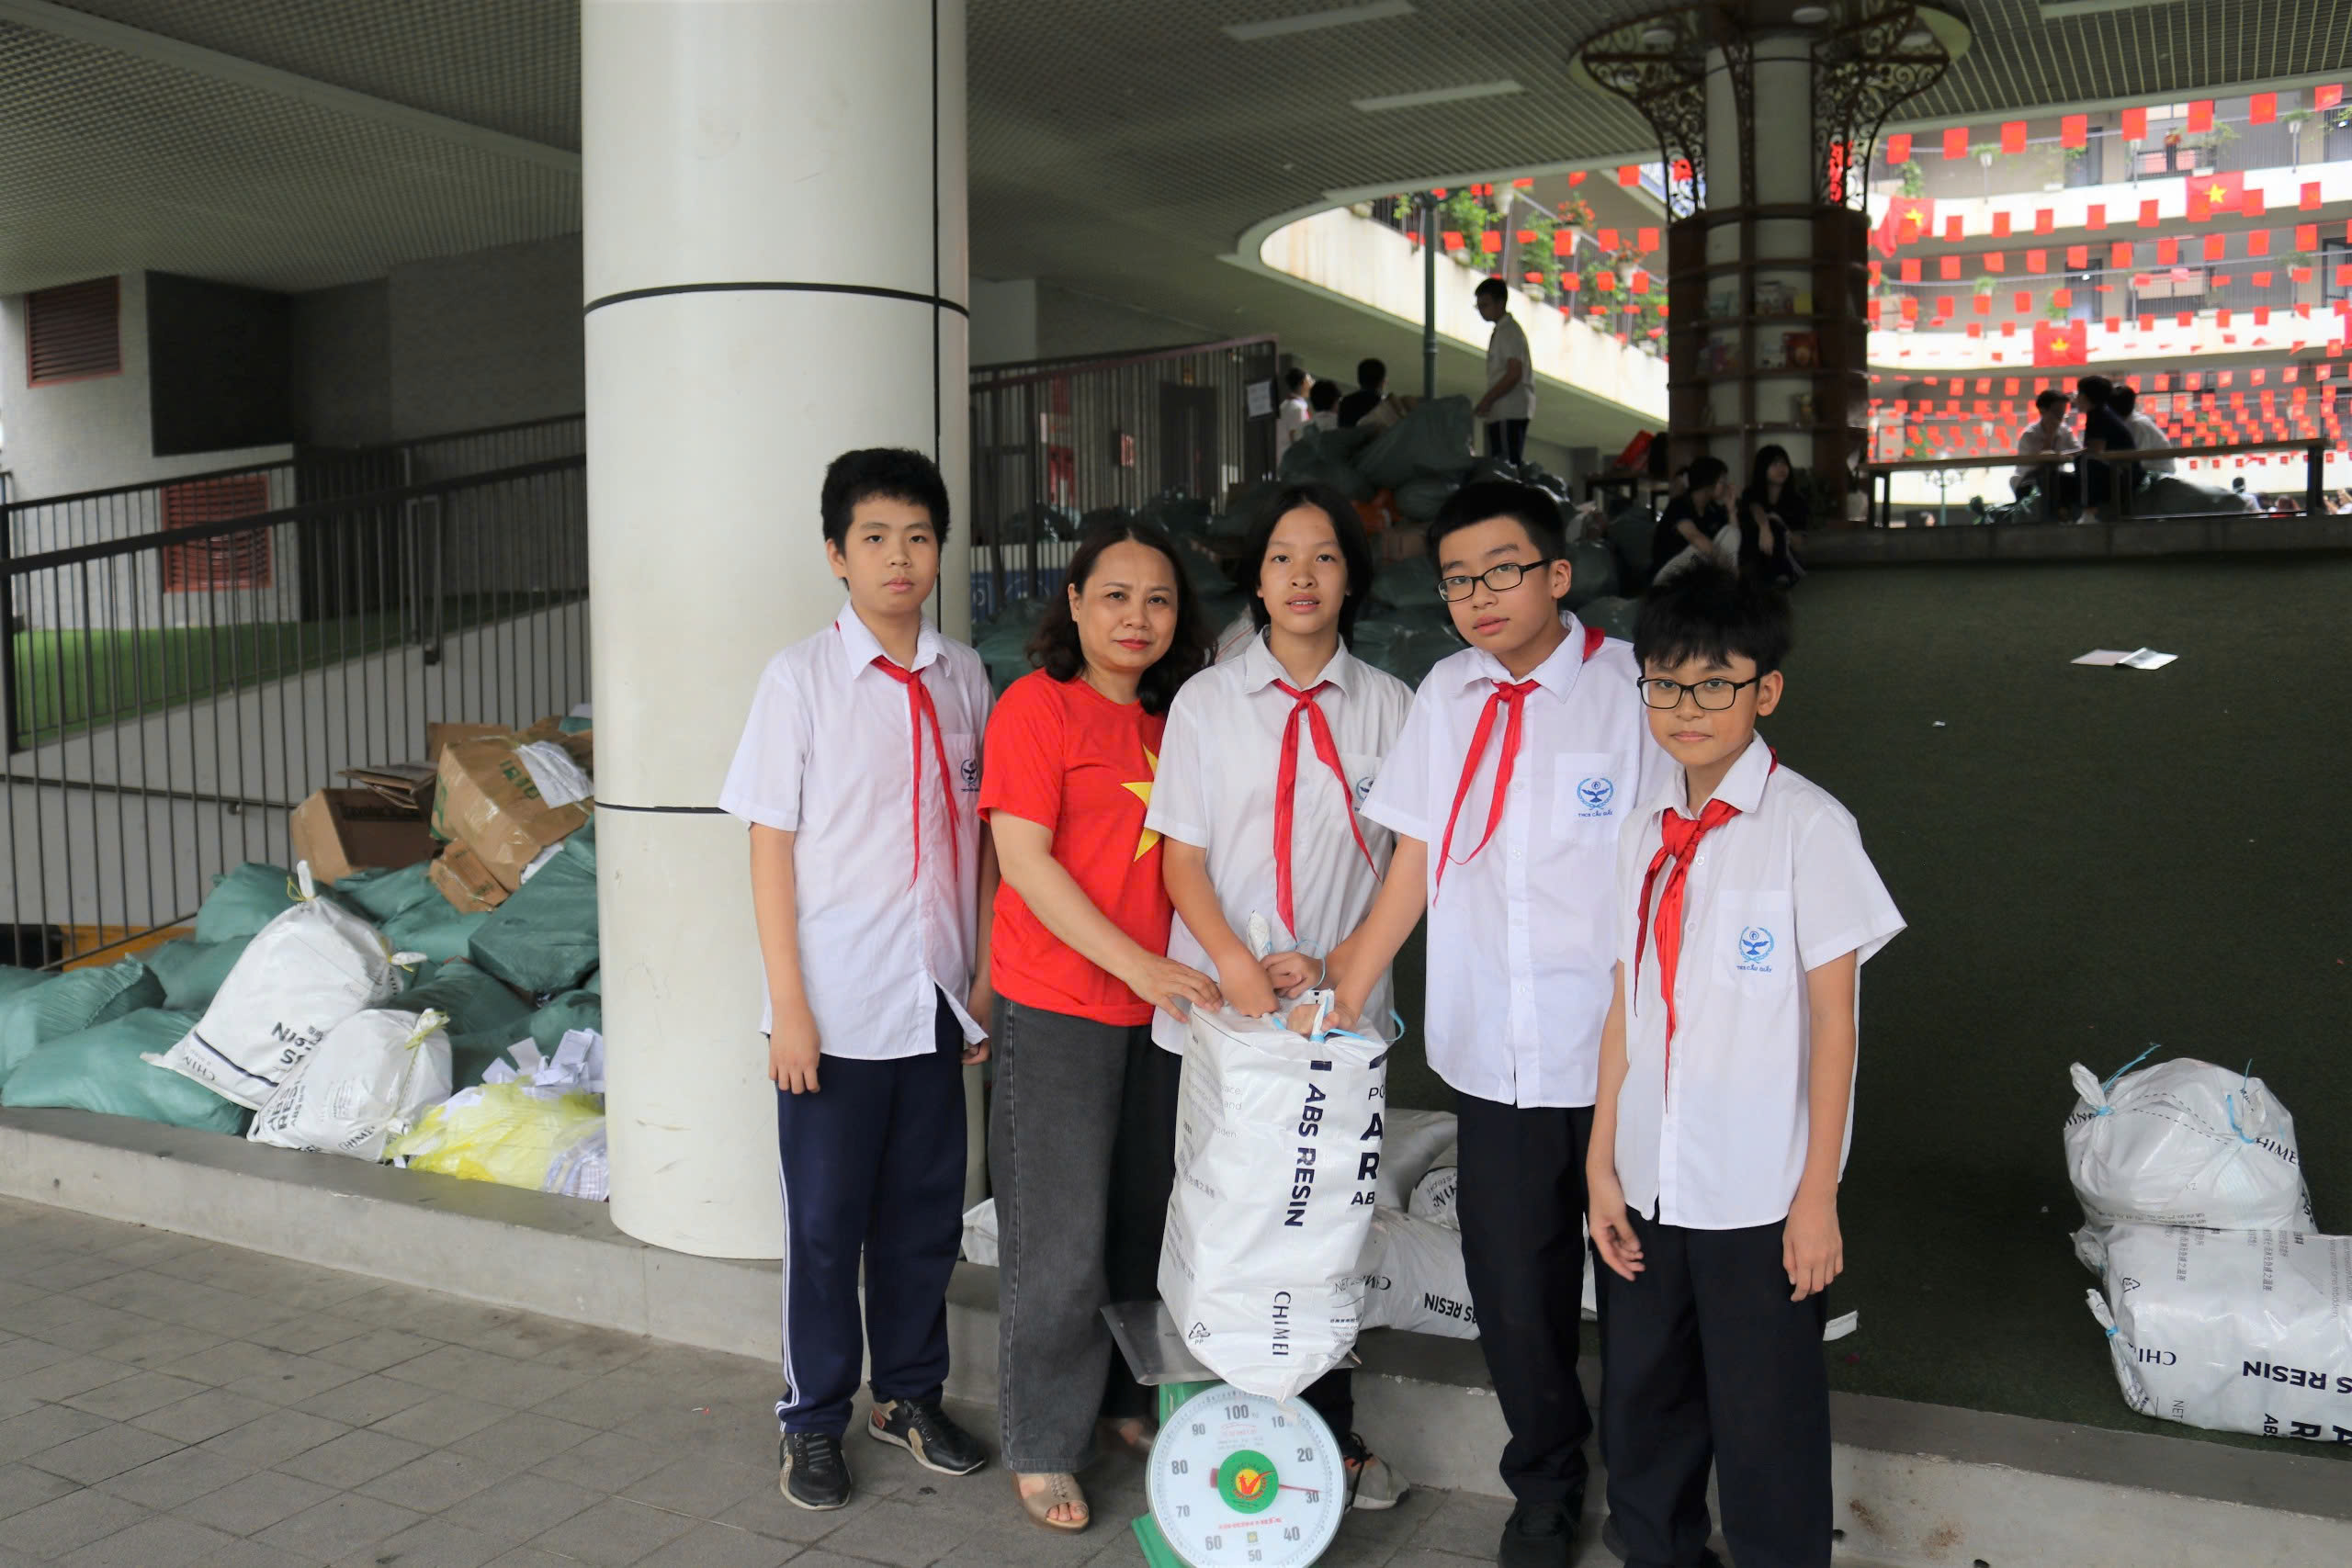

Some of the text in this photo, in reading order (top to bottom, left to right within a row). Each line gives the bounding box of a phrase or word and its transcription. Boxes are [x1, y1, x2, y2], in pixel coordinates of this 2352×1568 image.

[1283, 1082, 1328, 1228] ABS RESIN
[2256, 1137, 2298, 1165] HIME
[1424, 1292, 1463, 1319] RESIN
[1272, 1290, 1292, 1358] CHIMEI
[2139, 1348, 2177, 1367] CHI
[2242, 1360, 2327, 1391] RESIN
[1224, 1404, 1250, 1420] 100
[1192, 1423, 1206, 1436] 90
[1271, 1416, 1285, 1428] 10
[1296, 1447, 1314, 1462] 20
[1171, 1460, 1189, 1475] 80
[1306, 1491, 1320, 1504] 30
[1176, 1505, 1191, 1517] 70
[1283, 1526, 1301, 1542] 40
[1204, 1536, 1223, 1551] 60
[1248, 1550, 1262, 1562] 50
